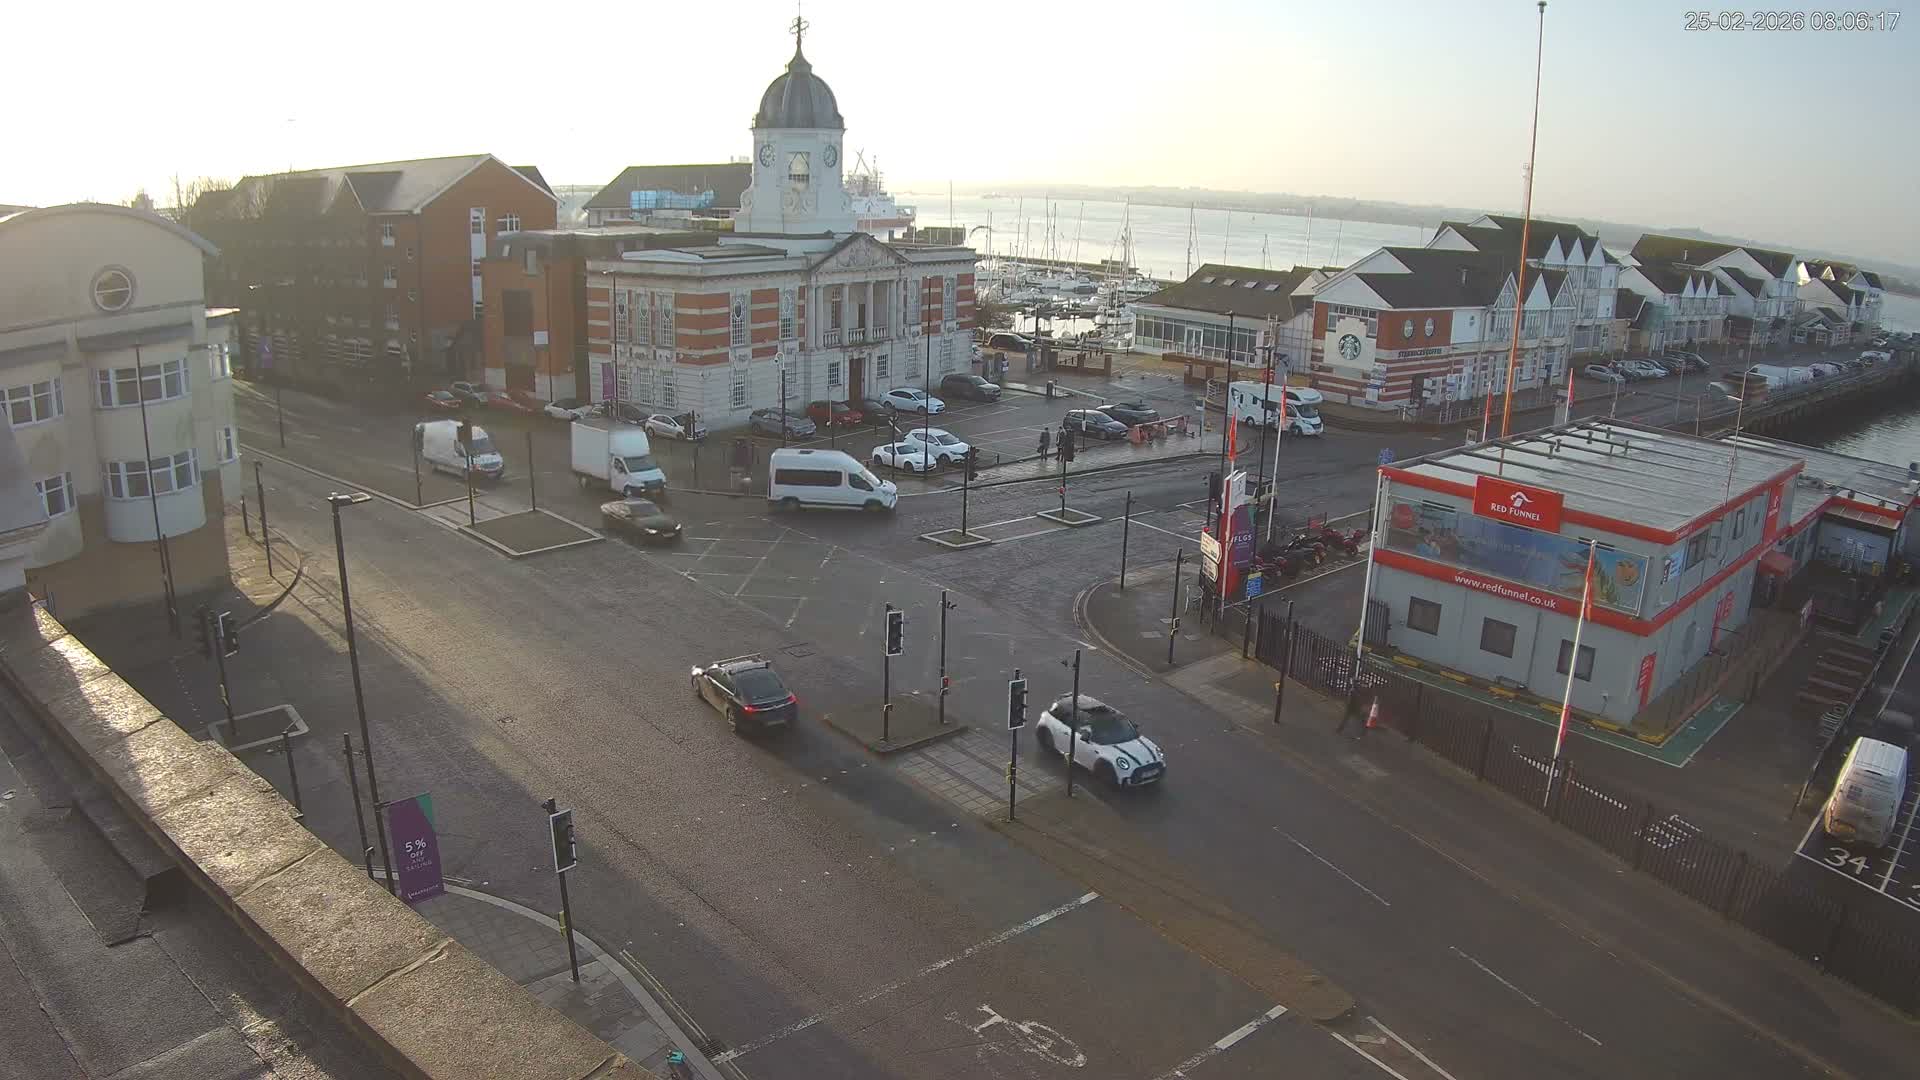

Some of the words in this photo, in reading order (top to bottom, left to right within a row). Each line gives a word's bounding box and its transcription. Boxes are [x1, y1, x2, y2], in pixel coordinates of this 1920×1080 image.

[1491, 502, 1507, 513] RED
[1509, 507, 1541, 521] FUNNEL
[1454, 574, 1557, 609] www.redfunnel.co.uk
[410, 850, 424, 859] OFF
[1824, 847, 1870, 875] 34
